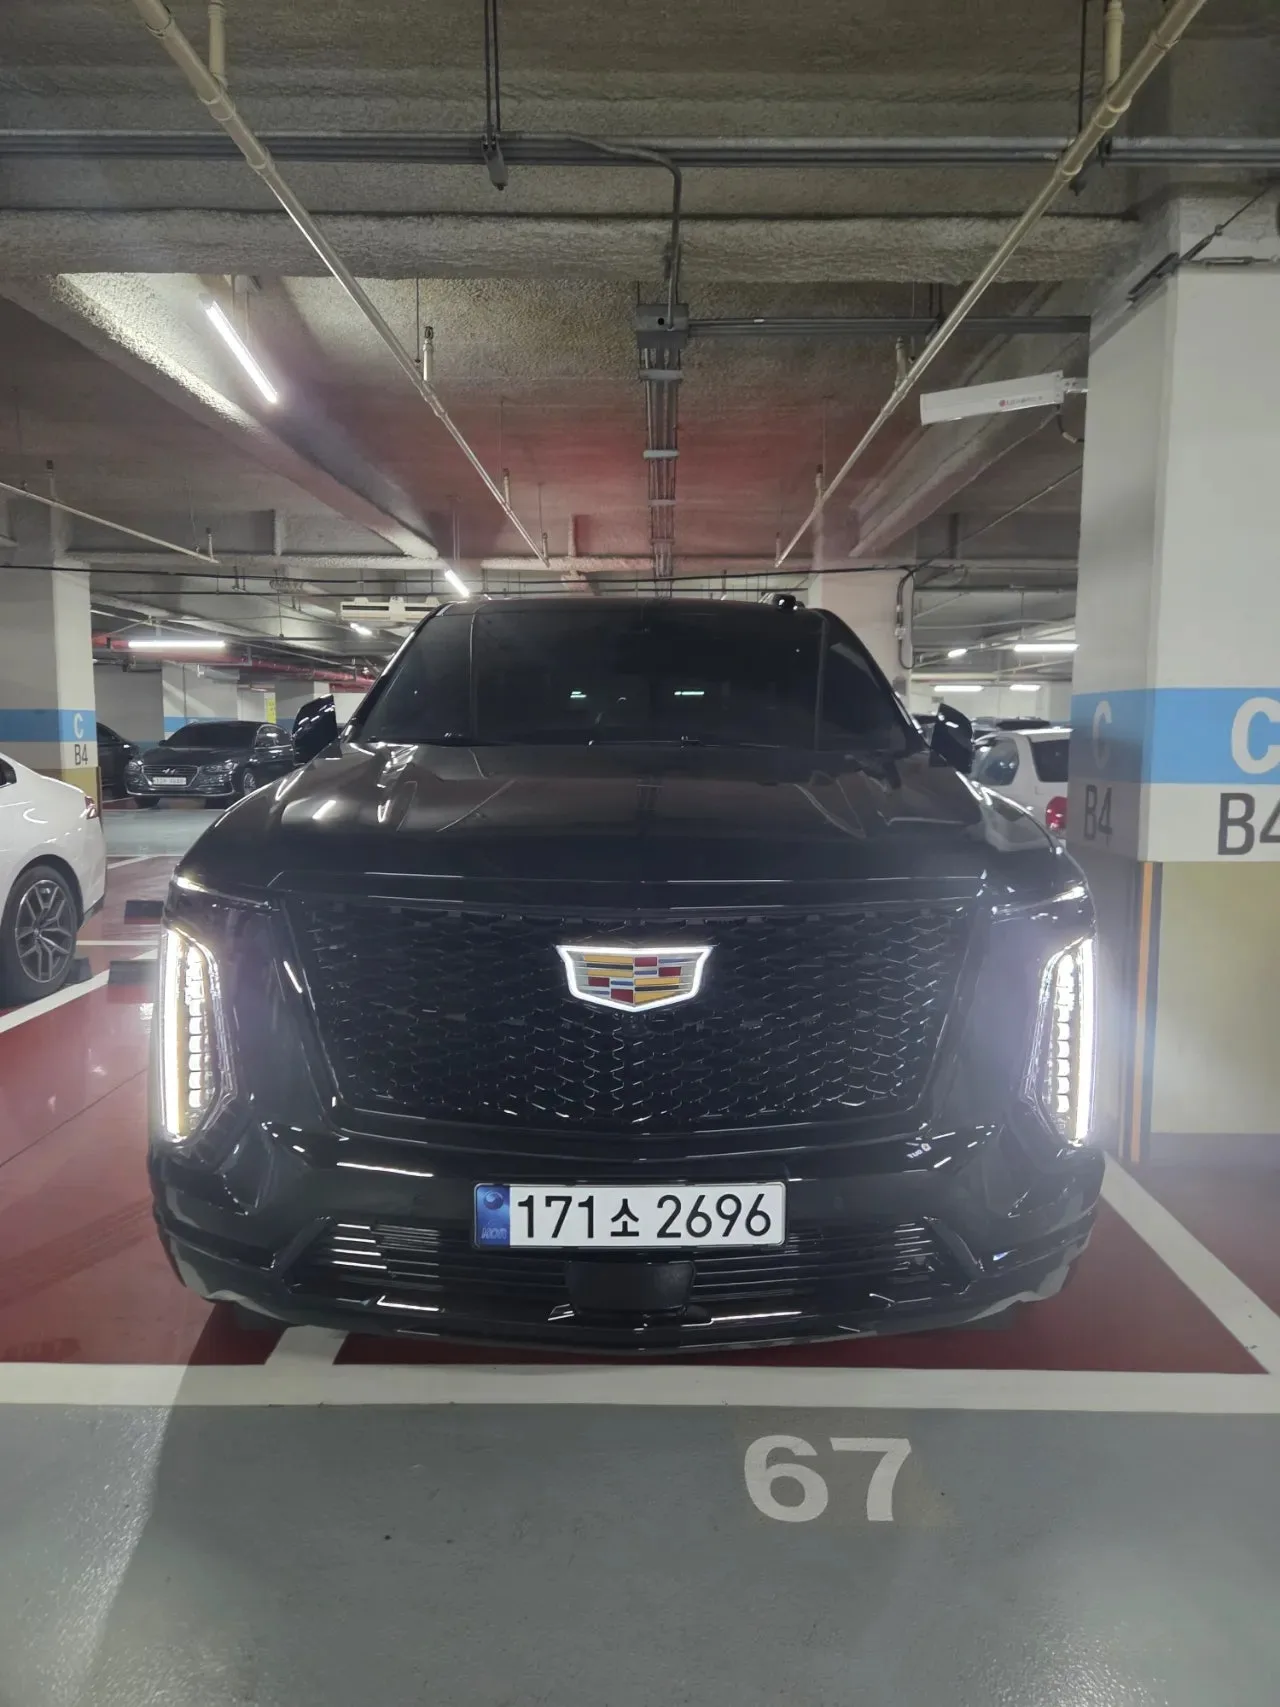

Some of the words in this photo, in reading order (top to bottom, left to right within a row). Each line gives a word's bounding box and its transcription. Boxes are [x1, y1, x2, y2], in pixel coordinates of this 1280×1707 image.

[74, 713, 84, 740] C
[74, 744, 89, 766] B4
[1092, 699, 1112, 769] C
[1231, 697, 1280, 775] C
[1083, 783, 1113, 848] B4
[655, 1193, 772, 1239] 2696
[744, 1434, 912, 1523] 67
